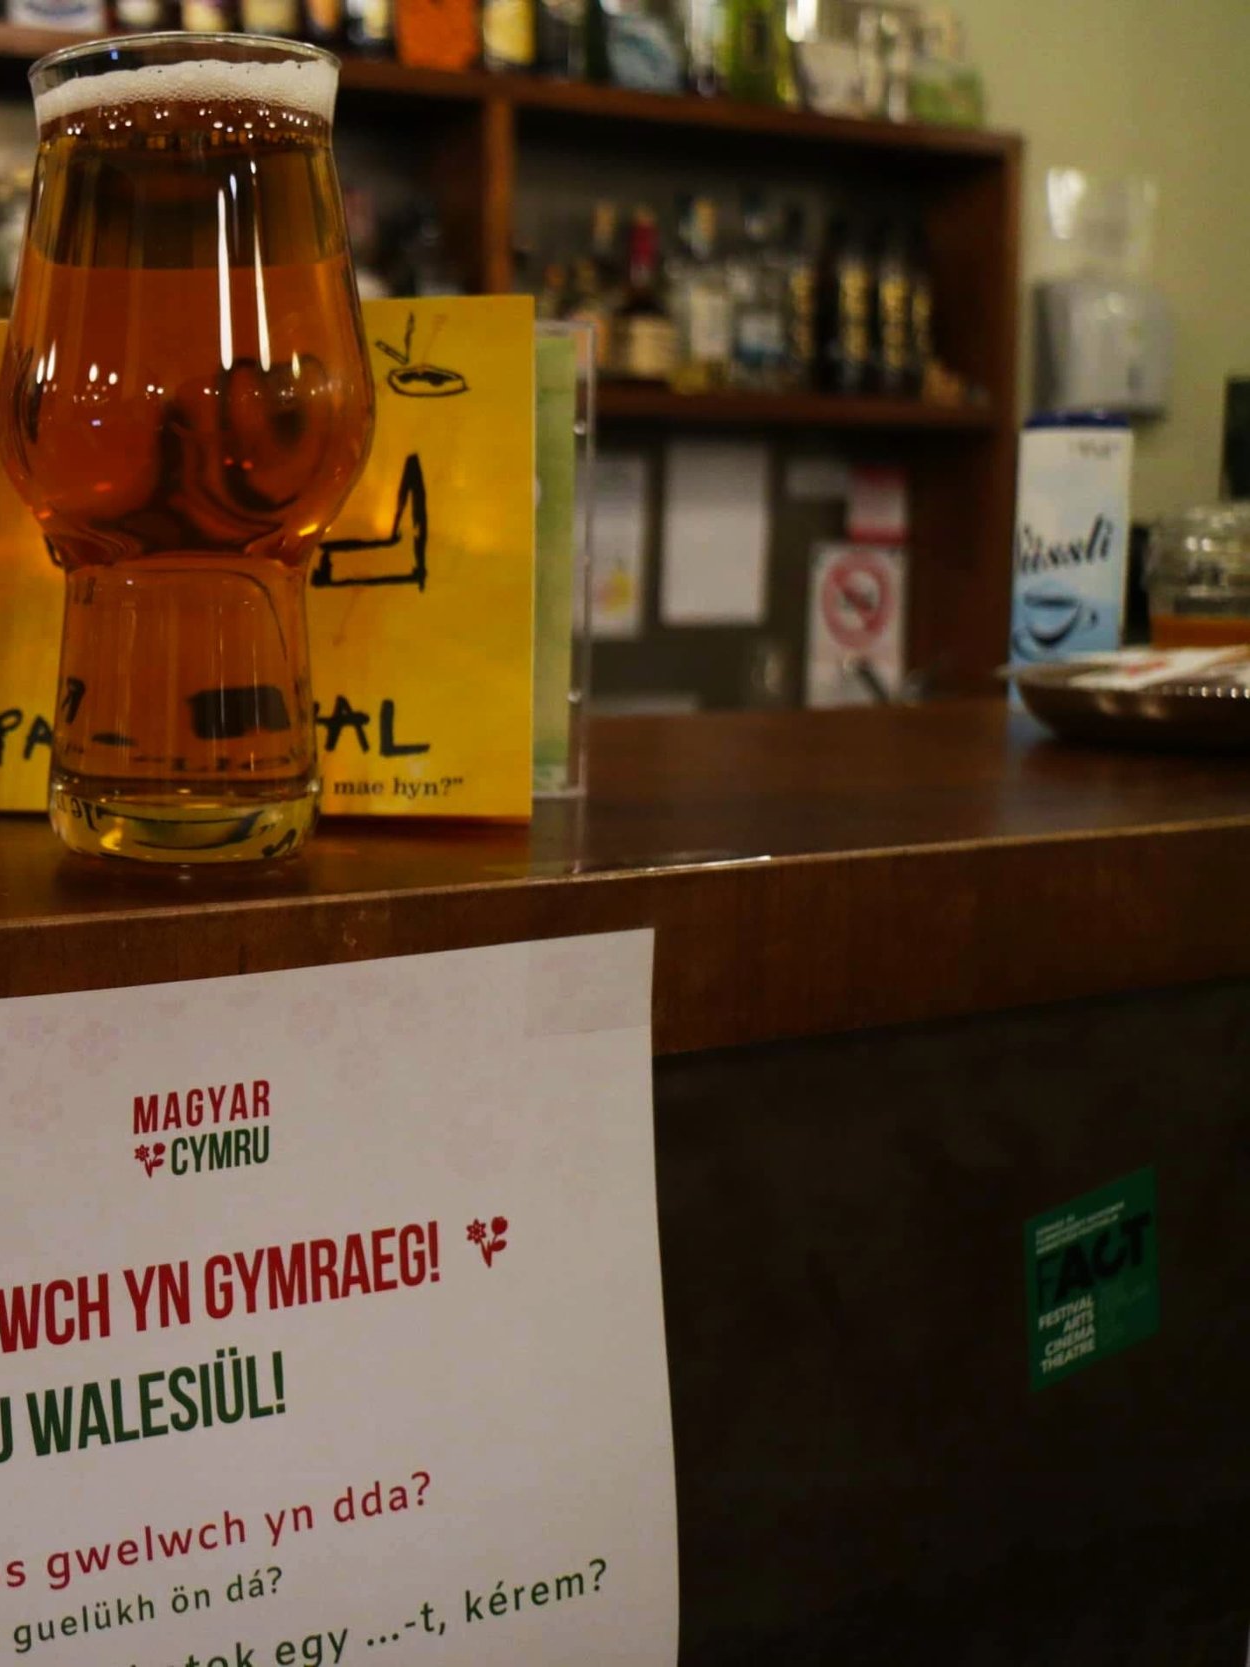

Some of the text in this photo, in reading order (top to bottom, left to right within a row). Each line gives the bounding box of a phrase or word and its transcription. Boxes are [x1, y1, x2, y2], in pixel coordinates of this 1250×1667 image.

[333, 777, 384, 796] mae
[134, 1079, 270, 1135] MAGYAR
[171, 1125, 269, 1176] CYMRU
[124, 1261, 192, 1332] YN
[203, 1220, 441, 1320] GYMRAEG!
[1036, 1210, 1149, 1313] FACT
[26, 1345, 286, 1457] WALESIÜL!
[47, 1510, 246, 1591] gwelwch
[264, 1503, 314, 1547] yn
[333, 1471, 431, 1523] dda?
[13, 1594, 155, 1653] guelükh
[171, 1586, 211, 1614] ön
[226, 1566, 282, 1602] dá?
[275, 1628, 347, 1667] egy
[465, 1558, 607, 1623] kérem?
